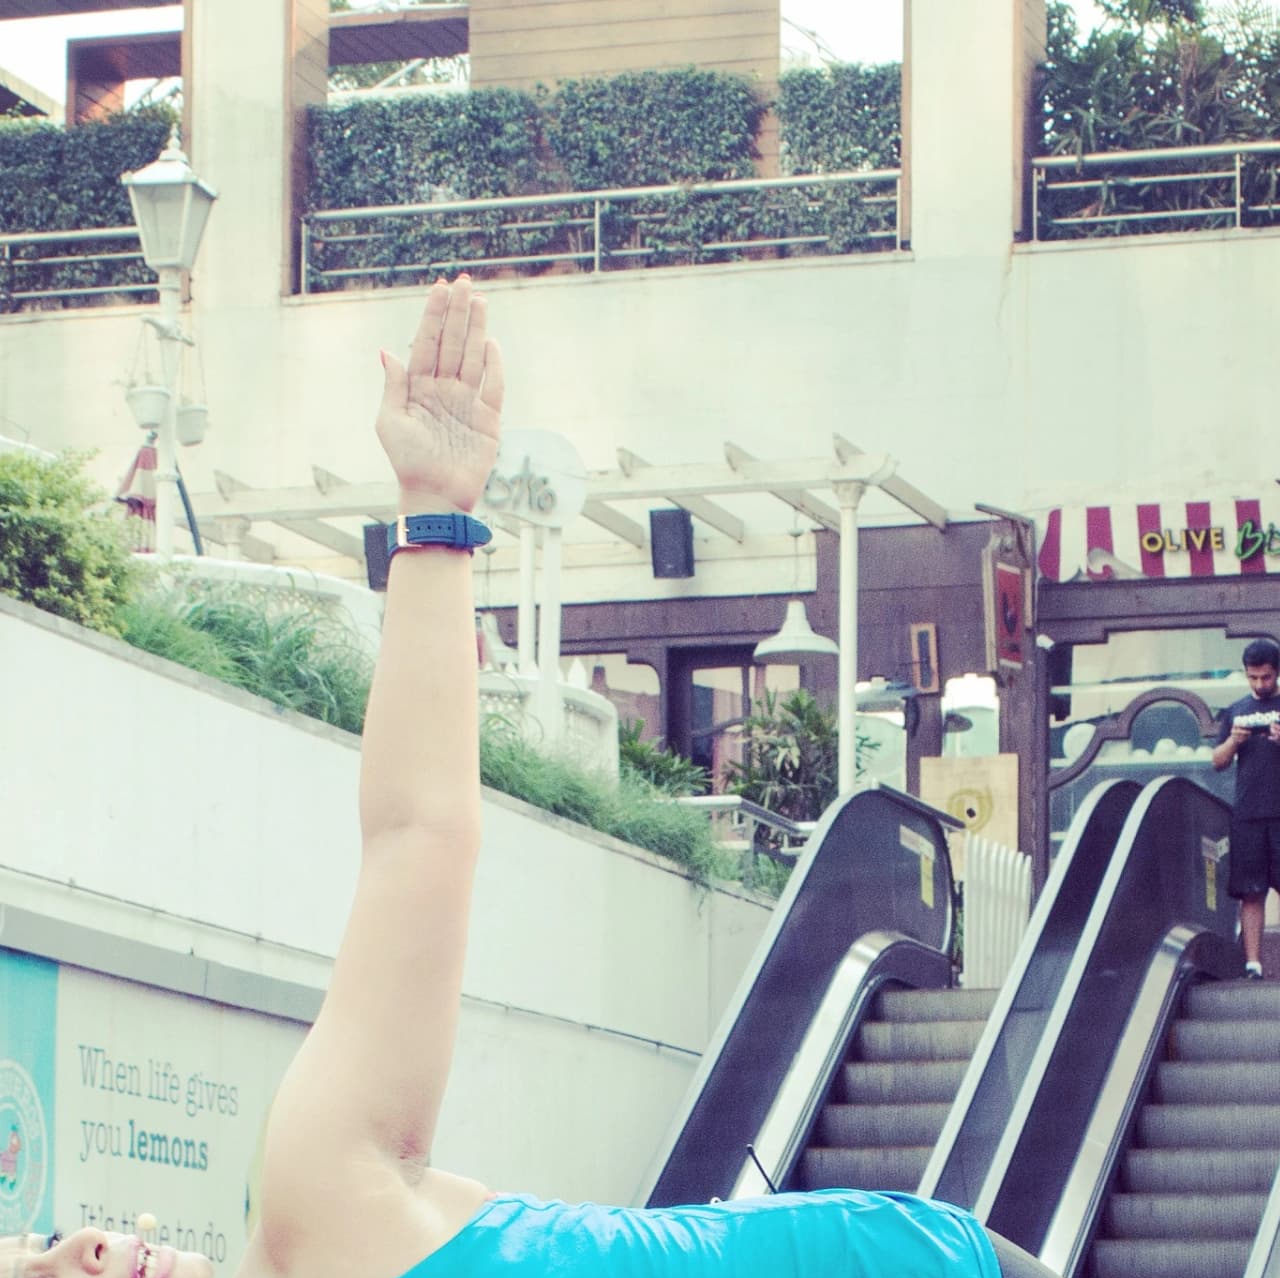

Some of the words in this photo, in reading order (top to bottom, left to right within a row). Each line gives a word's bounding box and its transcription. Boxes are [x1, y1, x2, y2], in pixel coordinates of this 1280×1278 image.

[1141, 527, 1225, 553] OLIVE
[78, 1044, 141, 1097] When
[147, 1058, 180, 1105] life
[185, 1071, 238, 1118] gives
[79, 1119, 123, 1163] you
[128, 1118, 208, 1171] lemons
[202, 1221, 226, 1263] do
